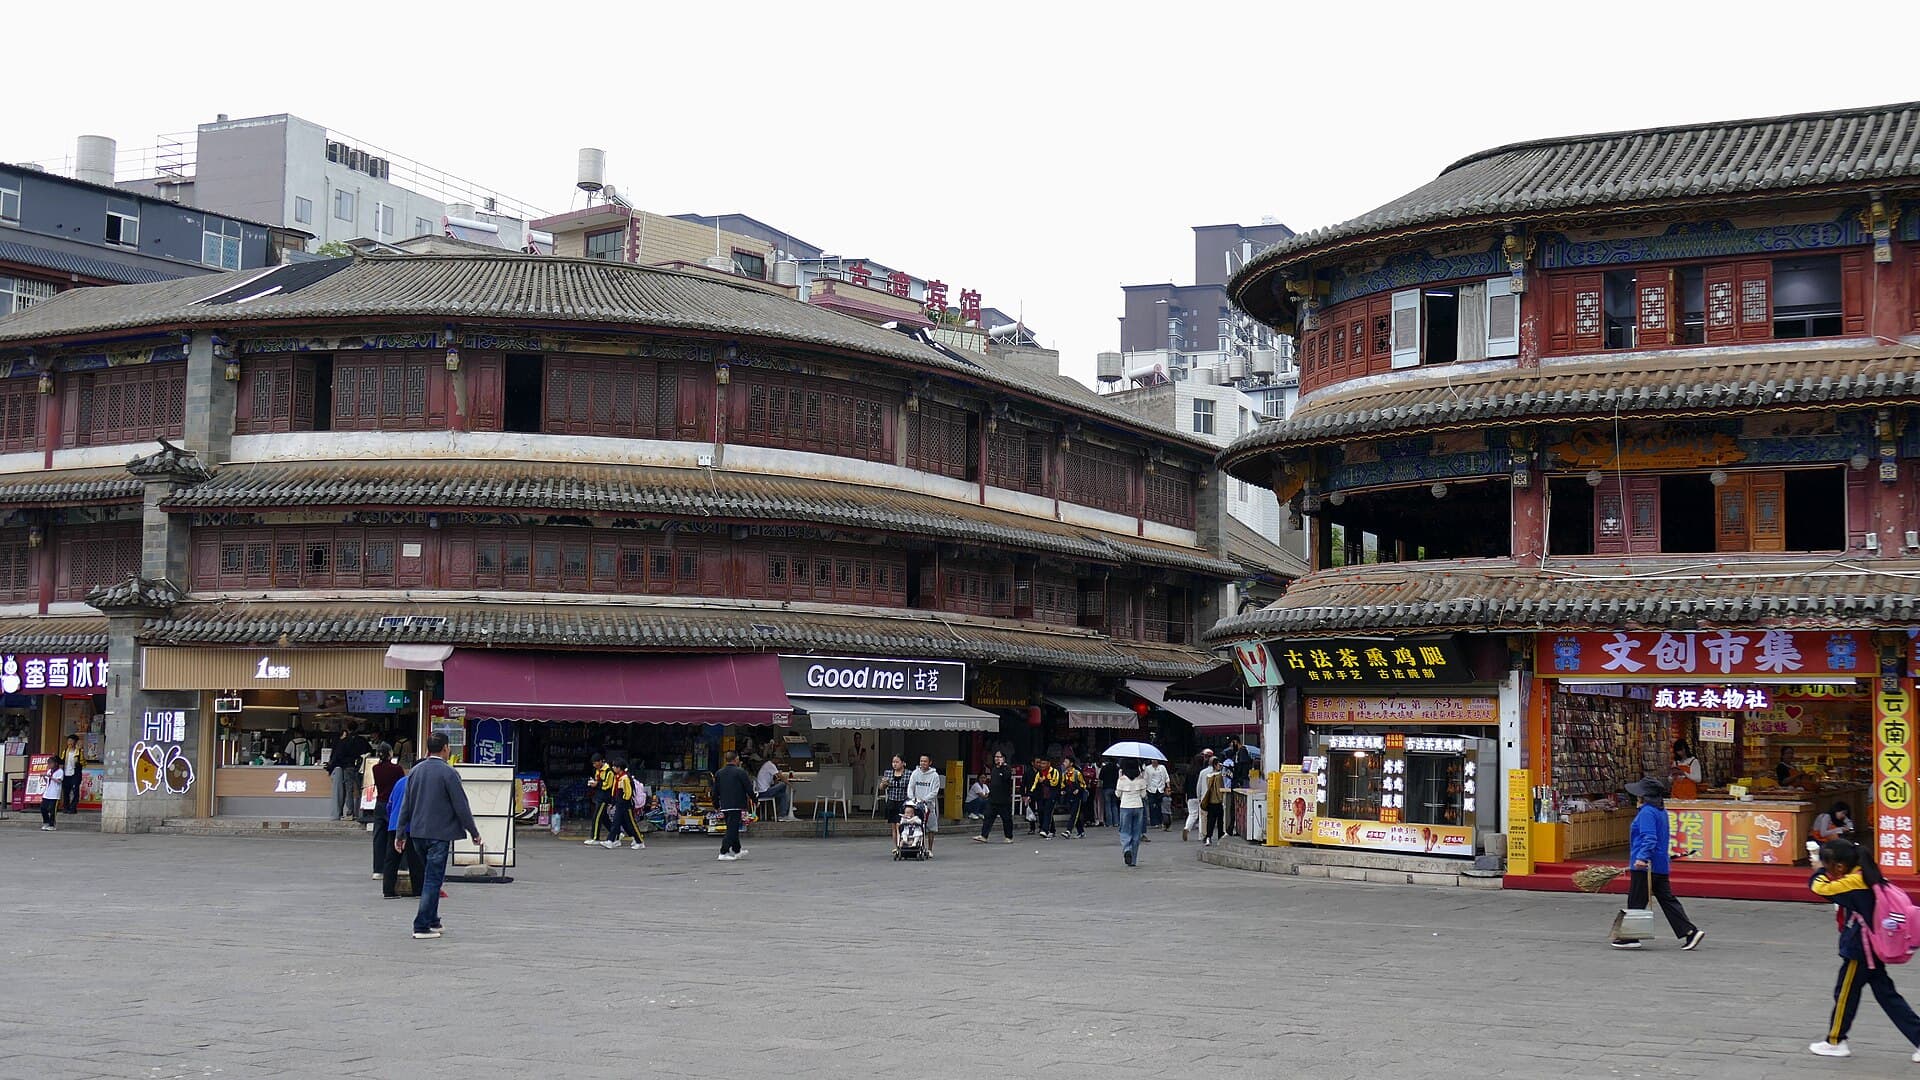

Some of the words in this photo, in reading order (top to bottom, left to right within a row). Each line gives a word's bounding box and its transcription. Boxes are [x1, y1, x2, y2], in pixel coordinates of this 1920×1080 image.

[1284, 646, 1447, 669] 古法茶熏鸡腿
[1601, 629, 1803, 674] 文创市集
[807, 664, 870, 688] Good
[872, 669, 905, 690] me
[913, 667, 940, 692] 古茗
[1308, 669, 1363, 681] 传承手艺
[1654, 688, 1768, 710] 疯狂杂物社
[143, 711, 172, 742] Hi
[831, 717, 847, 726] Good
[889, 719, 901, 727] ONE
[902, 719, 913, 728] CUP
[920, 720, 931, 728] DAY
[944, 719, 958, 728] Good
[1882, 690, 1908, 803] 云南文创
